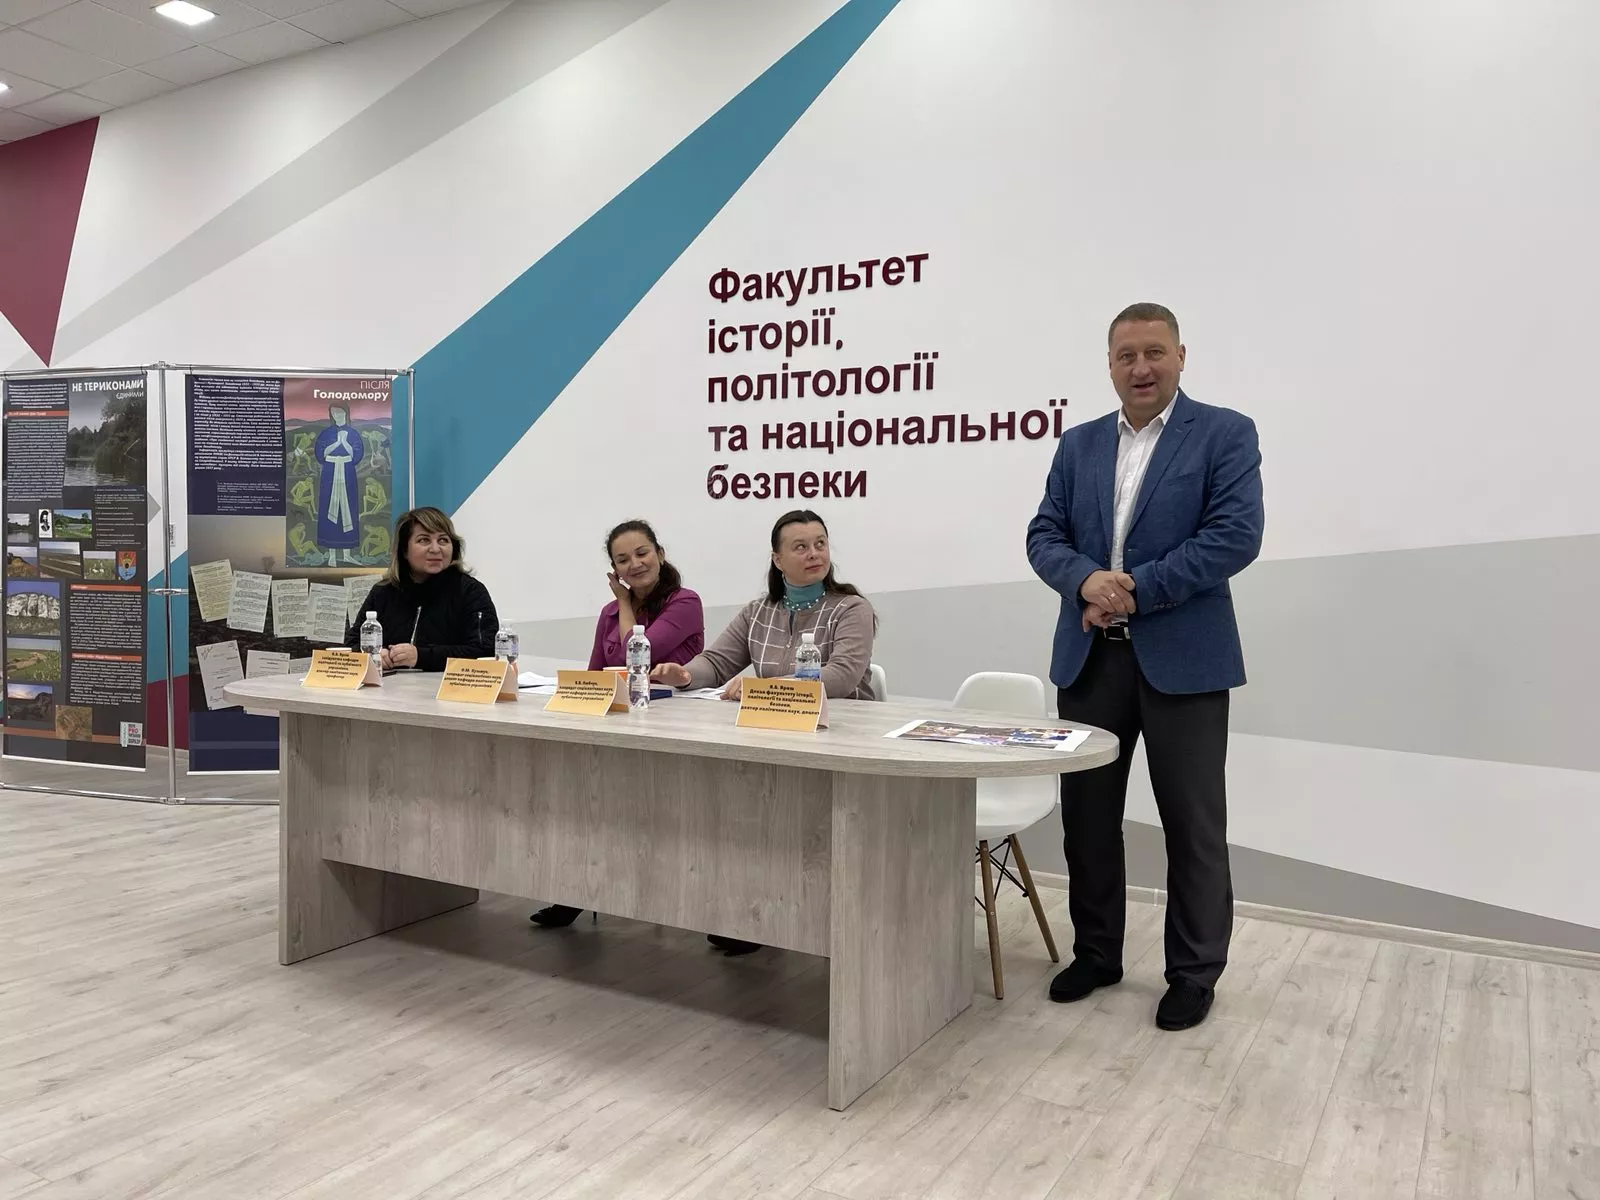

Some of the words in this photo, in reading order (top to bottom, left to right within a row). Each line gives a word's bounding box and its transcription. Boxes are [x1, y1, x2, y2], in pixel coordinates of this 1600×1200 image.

[708, 252, 929, 307] Факультет
[708, 307, 844, 357] історії,
[72, 382, 83, 392] НЕ
[84, 379, 144, 391] ТЕРИКОНАМИ
[313, 389, 389, 402] Голодомору
[360, 380, 390, 390] ПІСЛЯ
[708, 351, 939, 403] політології
[708, 424, 748, 452] та
[762, 398, 1068, 454] національної
[707, 463, 868, 500] безпеки
